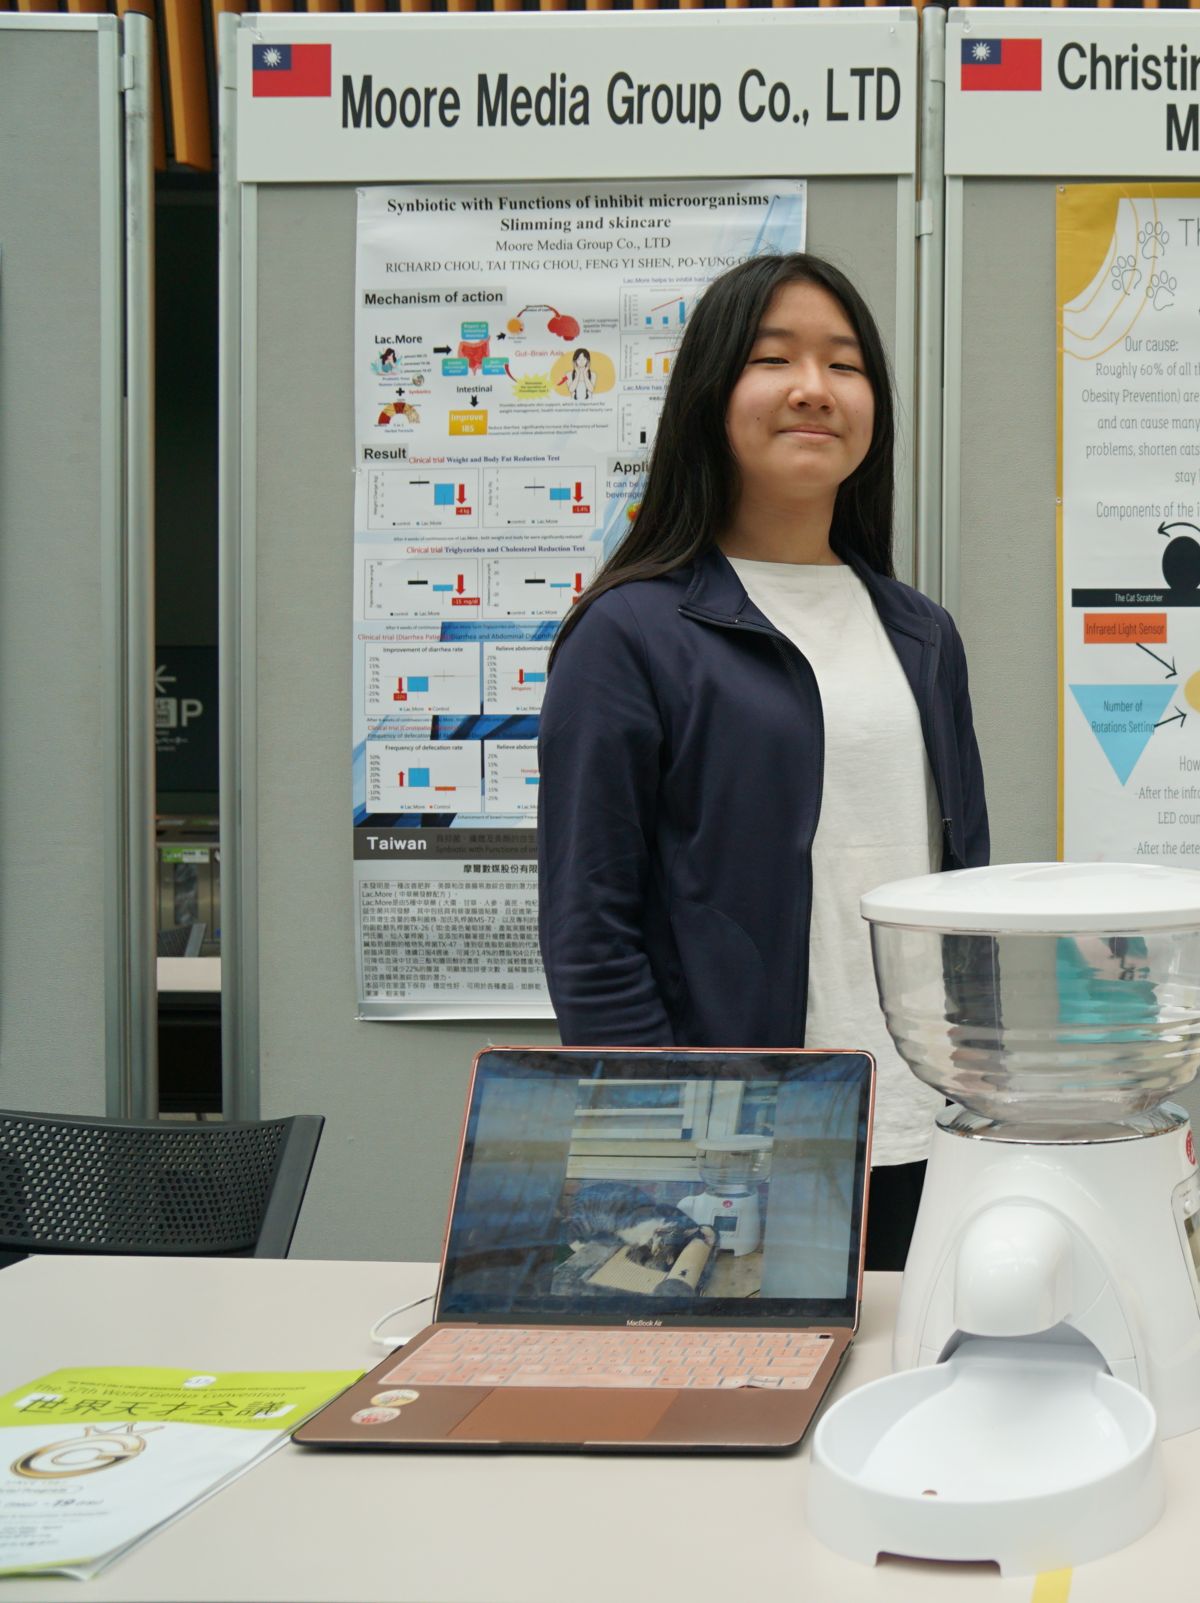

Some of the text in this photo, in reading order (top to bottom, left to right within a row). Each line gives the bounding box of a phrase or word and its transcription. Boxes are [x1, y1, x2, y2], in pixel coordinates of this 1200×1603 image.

[341, 67, 900, 130] Moore Media Group Co., LTD
[387, 198, 456, 215] Synbiotic
[461, 197, 493, 210] with
[498, 196, 571, 210] Functions
[575, 195, 590, 208] of
[594, 194, 643, 208] inhibit
[500, 215, 671, 233] Slimming and skincare
[495, 240, 533, 251] Moore
[537, 239, 573, 250] Media
[576, 238, 613, 252] Group
[644, 236, 670, 248] LTD
[385, 261, 441, 272] RICHARD
[486, 260, 506, 270] TAI
[510, 260, 540, 270] TING
[585, 258, 618, 269] FENG
[621, 258, 634, 268] YI
[364, 290, 503, 304] Mechanism of action
[1124, 336, 1179, 352] Our cause:
[1095, 361, 1138, 379] Roughly
[1166, 361, 1177, 376] of
[1178, 361, 1191, 376] all
[364, 447, 406, 459] Result
[446, 456, 468, 464] Weight
[483, 455, 499, 463] Body
[1174, 471, 1196, 486] stay
[1096, 501, 1160, 521] Components
[1163, 500, 1175, 518] of
[1176, 501, 1194, 518] the
[406, 546, 428, 554] Clinical
[444, 546, 485, 554] Triglycerides
[1115, 593, 1163, 602] The Cat Scratcher
[1086, 622, 1164, 639] Infrared Light Sensor
[181, 698, 203, 727] P
[1104, 700, 1143, 712] Number of
[1092, 720, 1155, 736] Rotations Setting
[1179, 755, 1200, 772] How
[1163, 785, 1180, 799] the
[366, 835, 426, 850] Taiwan
[626, 1319, 653, 1327] MacBook
